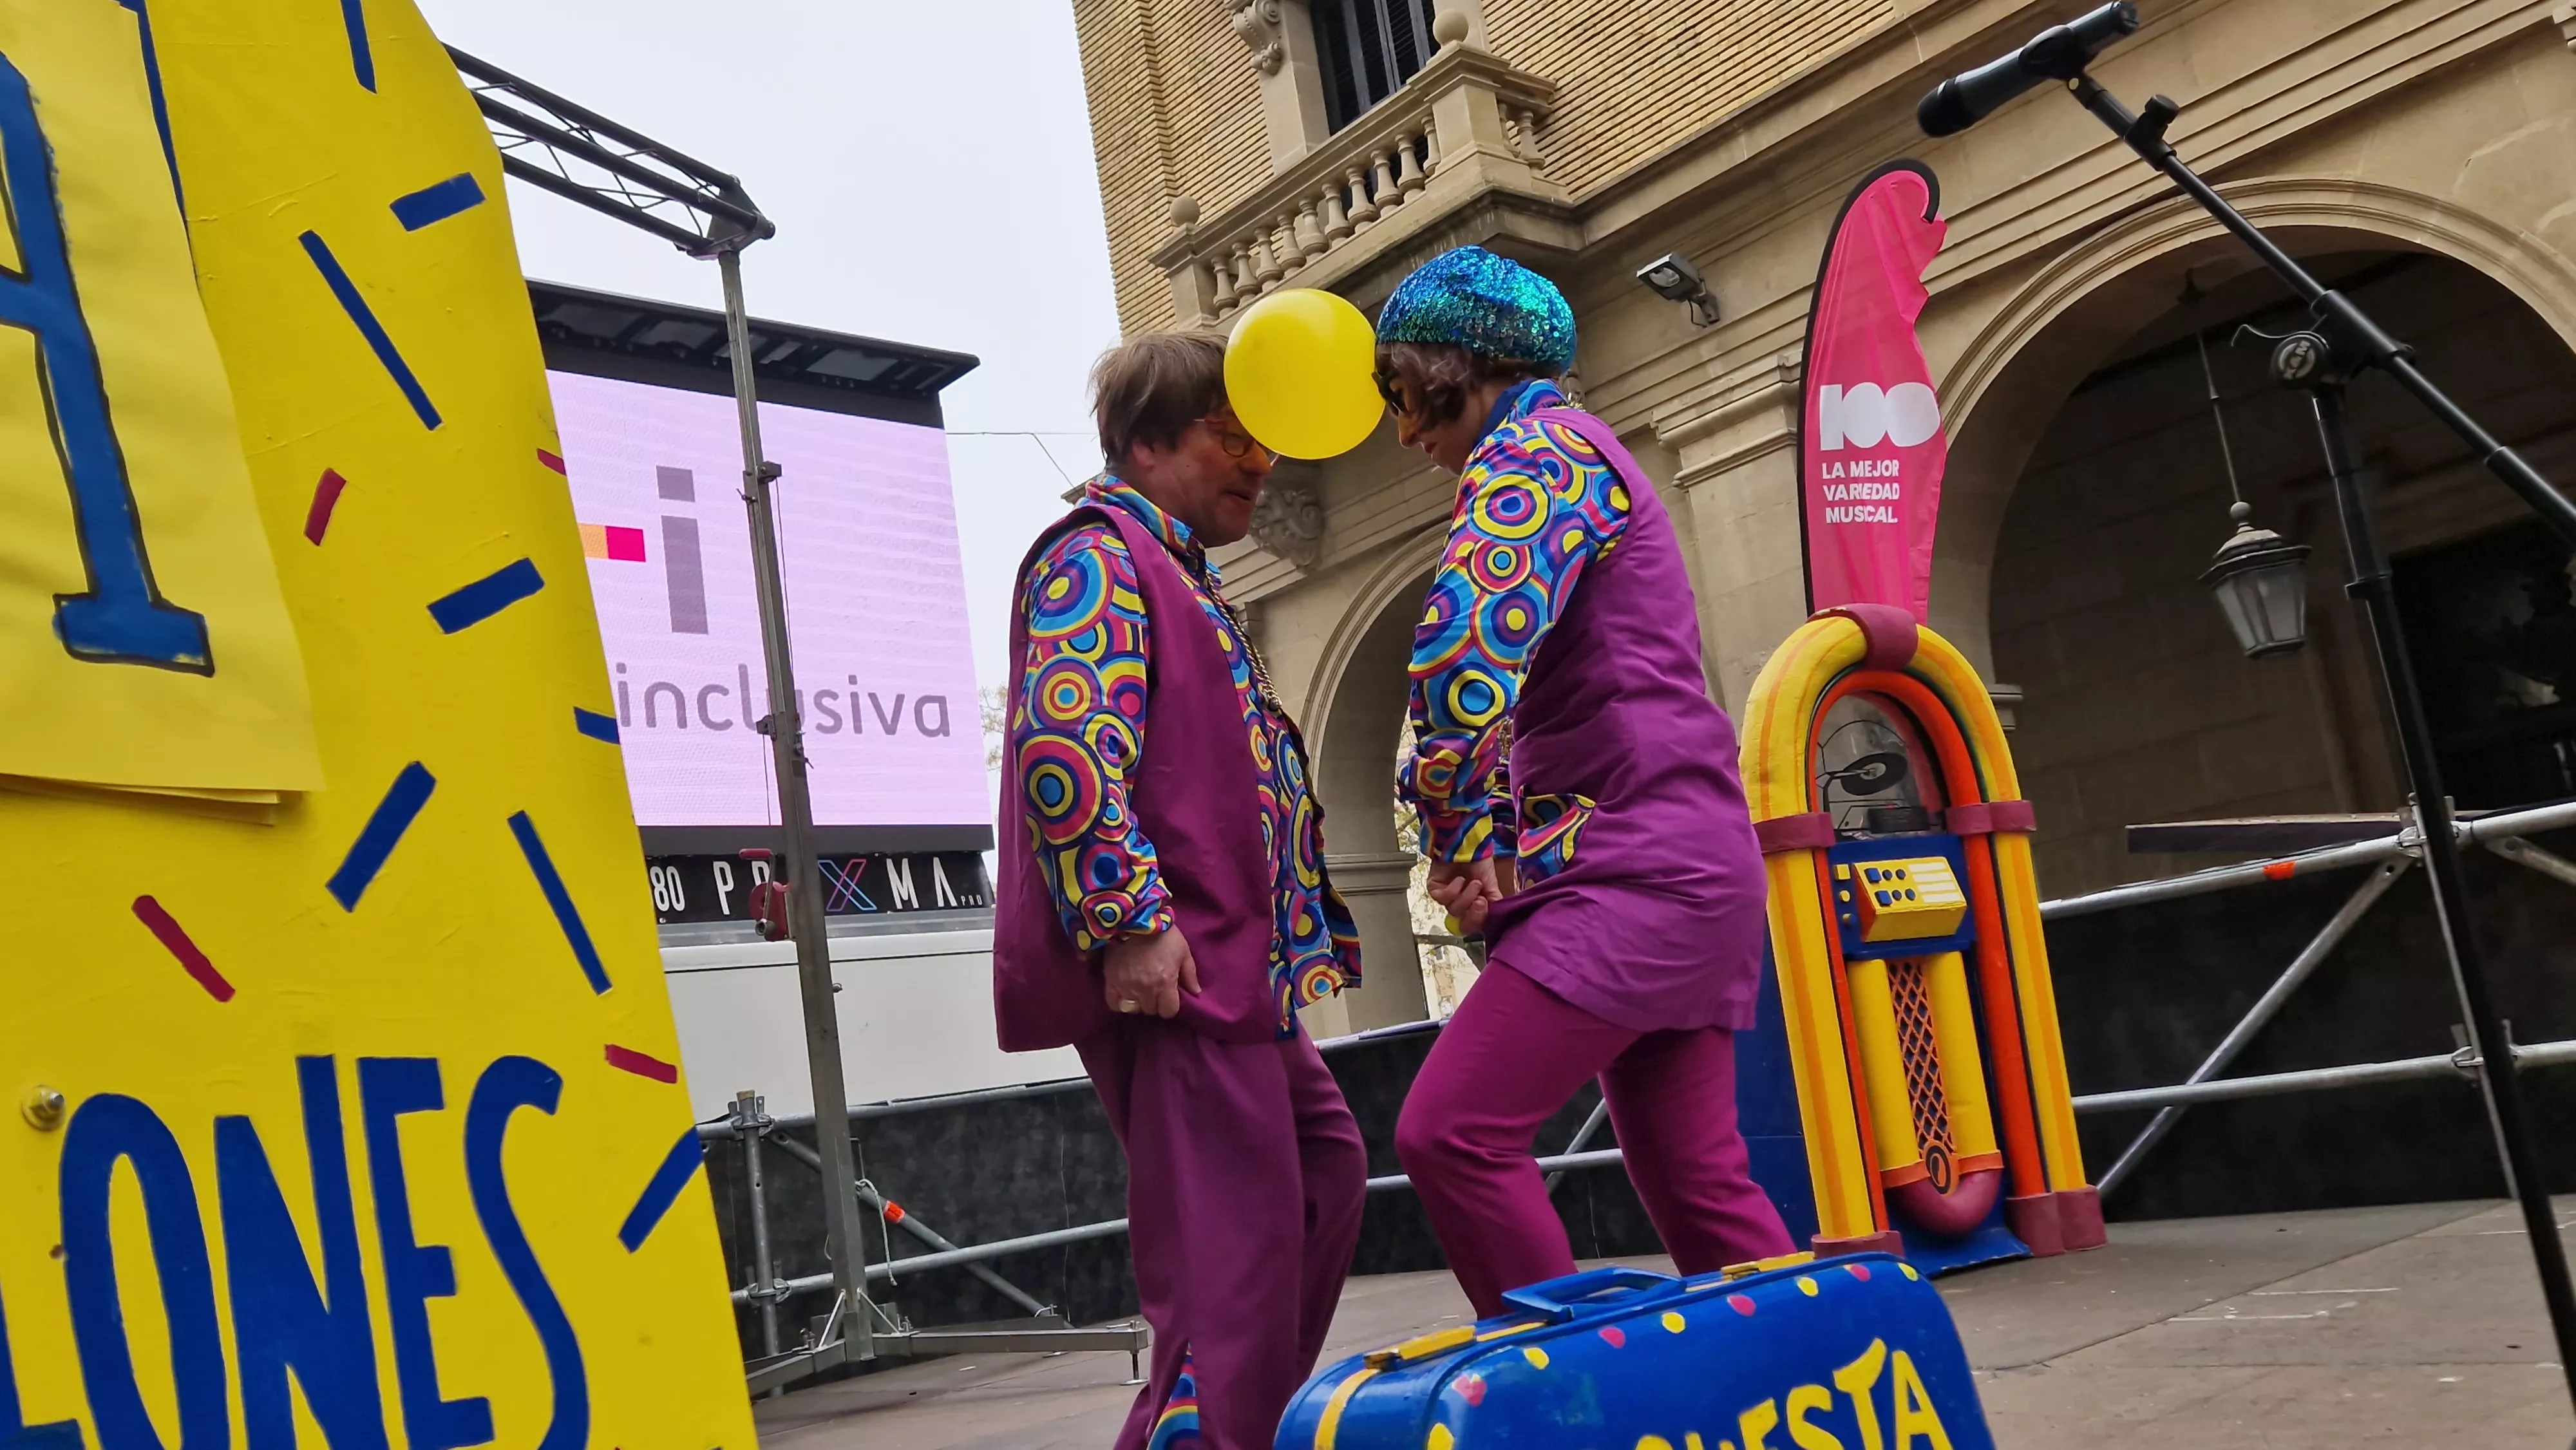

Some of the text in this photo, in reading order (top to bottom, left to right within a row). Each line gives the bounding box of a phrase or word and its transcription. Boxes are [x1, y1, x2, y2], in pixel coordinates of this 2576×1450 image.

[1822, 459, 1899, 479] LA MEJOR
[1823, 482, 1900, 501] VARIEDAD
[616, 662, 951, 738] inclsiva
